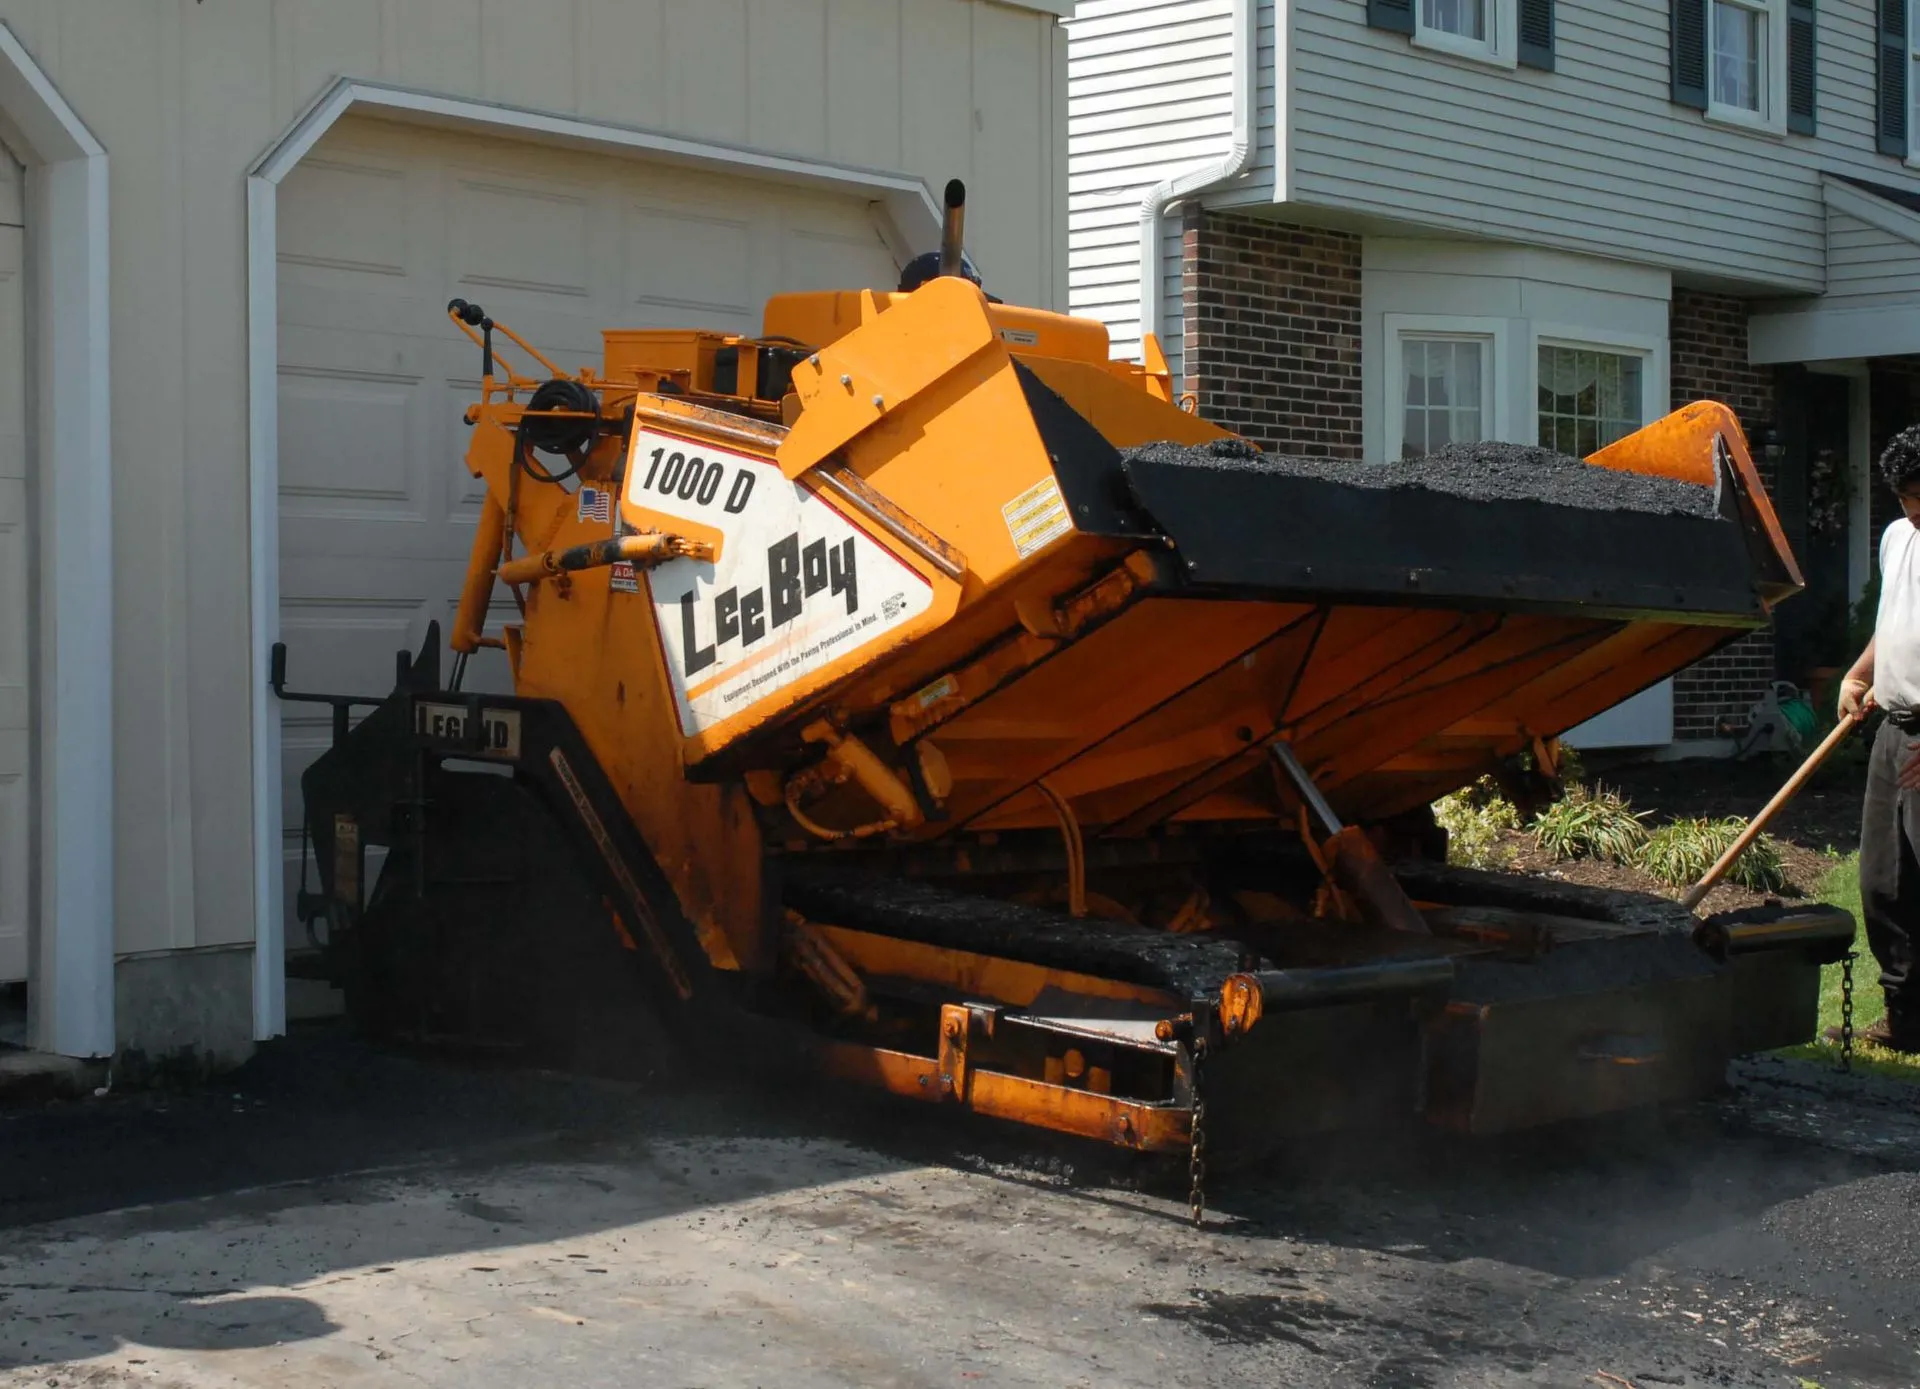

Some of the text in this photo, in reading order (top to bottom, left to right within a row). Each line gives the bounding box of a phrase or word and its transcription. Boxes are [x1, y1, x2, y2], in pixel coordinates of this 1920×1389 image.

[643, 446, 756, 514] 1000 D
[723, 683, 752, 703] Equipment
[751, 666, 777, 688] Designed
[790, 656, 800, 667] the
[800, 643, 820, 661] Paving
[819, 626, 855, 649] Professional
[861, 612, 878, 628] Mind.
